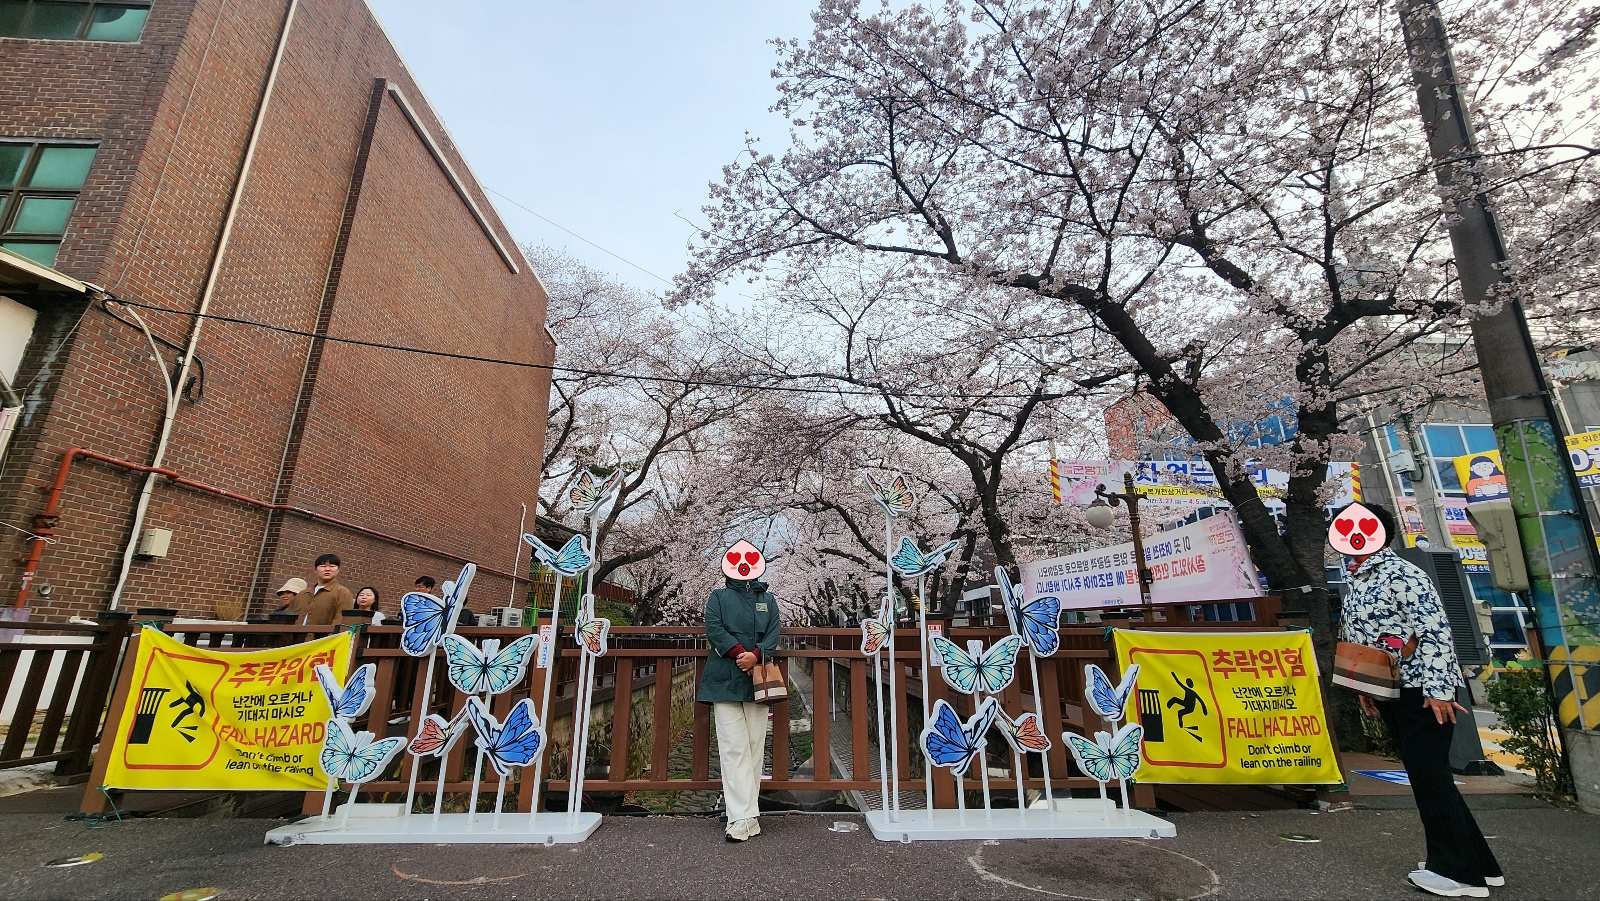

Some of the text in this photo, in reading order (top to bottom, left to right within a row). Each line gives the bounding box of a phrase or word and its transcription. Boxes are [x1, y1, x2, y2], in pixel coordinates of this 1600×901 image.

[1211, 647, 1307, 680] 추락위험
[1232, 684, 1297, 698] 난간에 오르거나
[233, 690, 313, 709] 난간에 오르거나
[1242, 698, 1298, 712] 기대지 마시오
[237, 705, 305, 722] 기대지 마시오
[1227, 715, 1321, 739] FALL HAZARD
[255, 721, 325, 748] HAZARD
[1247, 742, 1312, 756] Don't climb or
[225, 759, 250, 770] lean
[292, 754, 304, 763] or
[1240, 755, 1322, 769] lean on the railing
